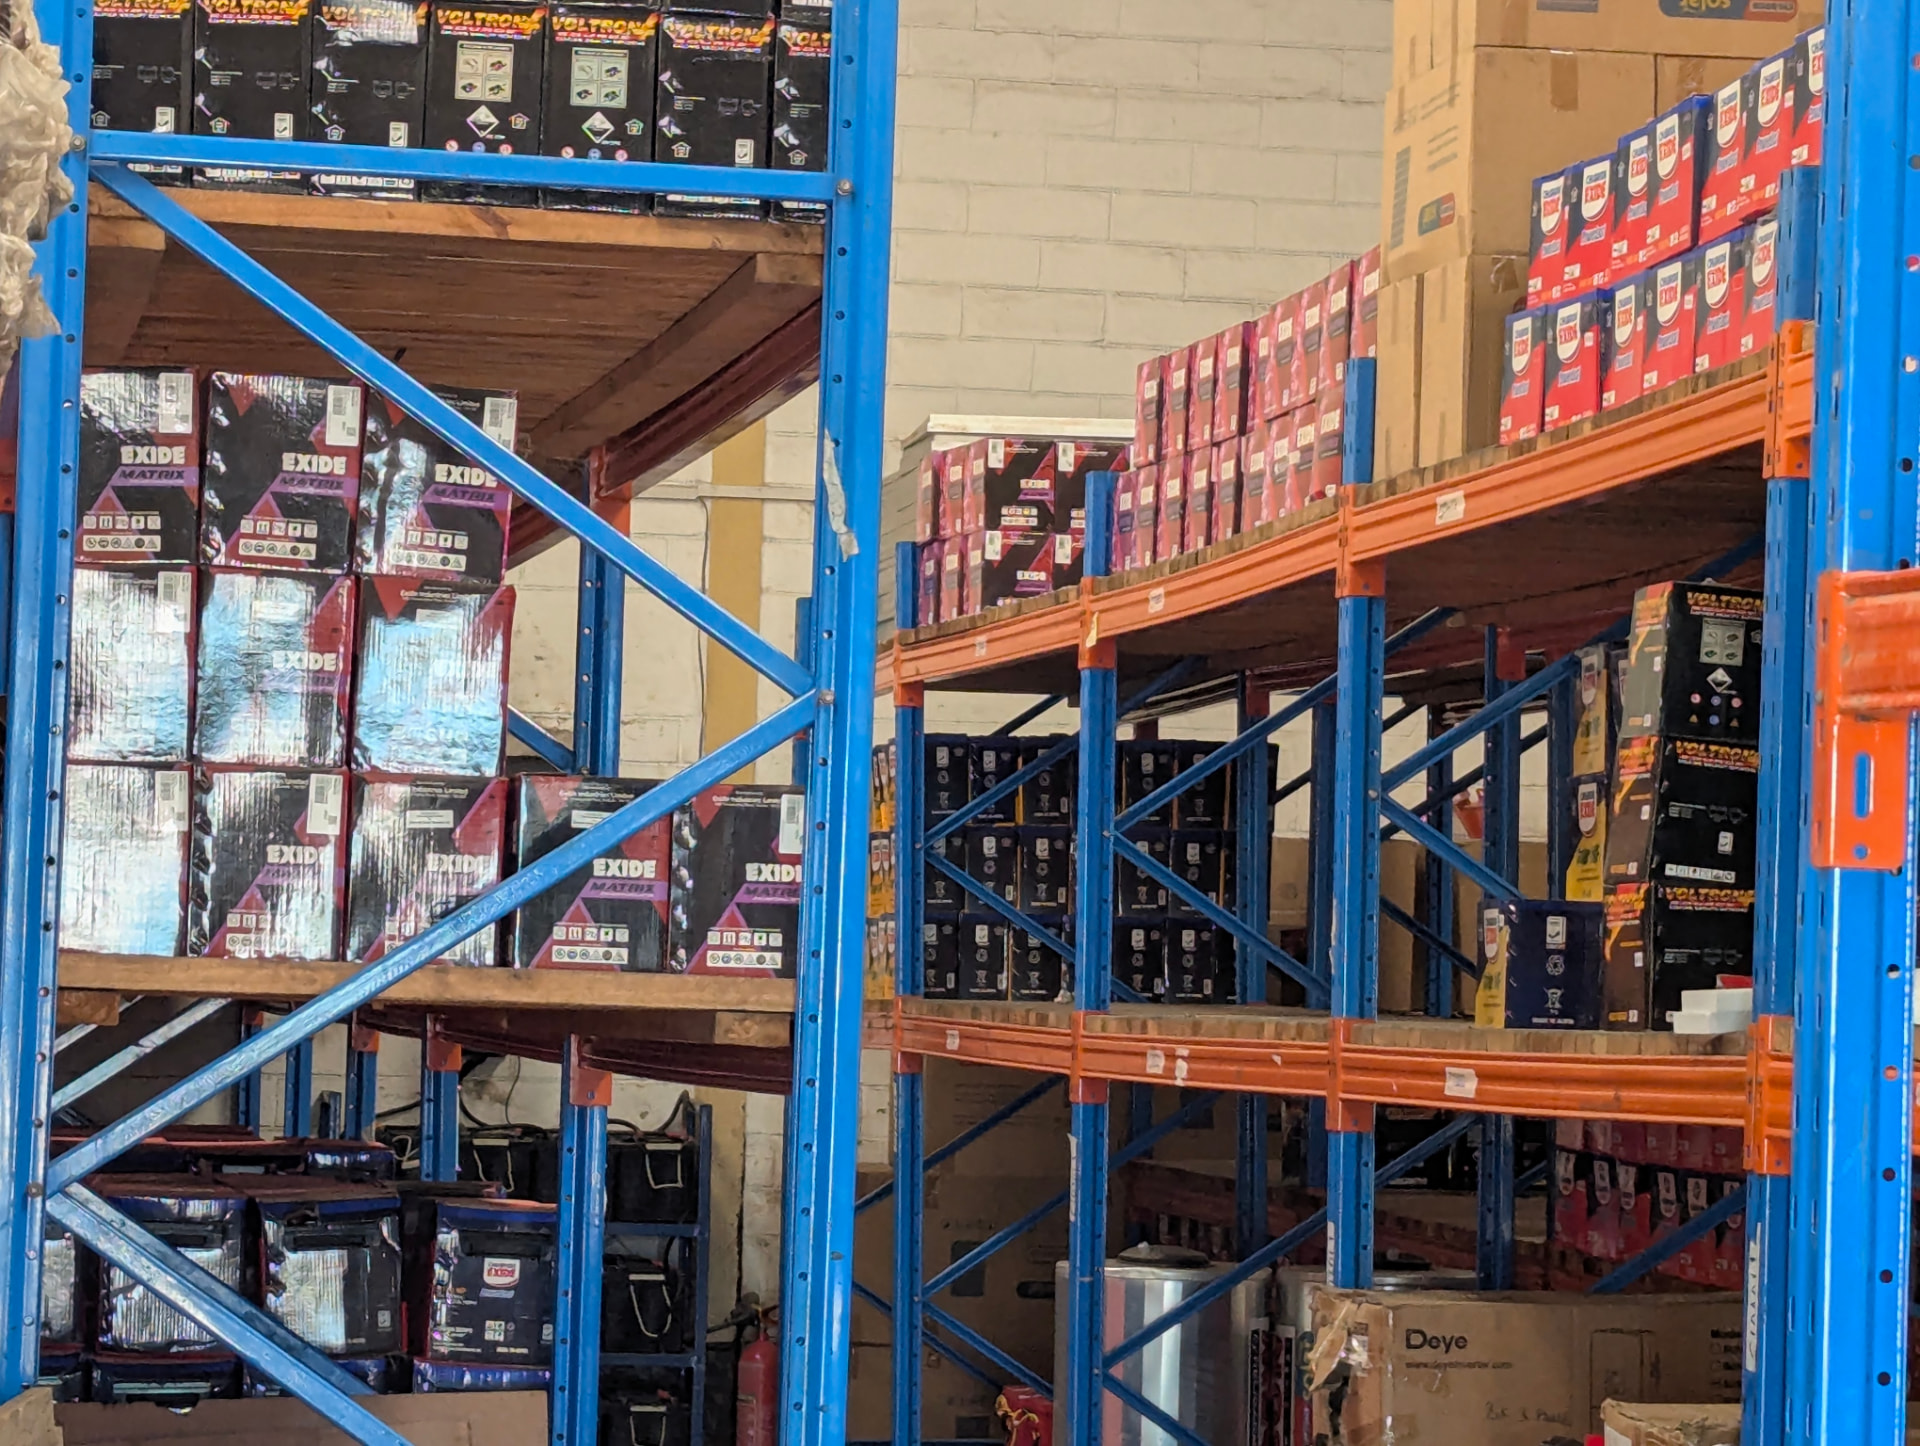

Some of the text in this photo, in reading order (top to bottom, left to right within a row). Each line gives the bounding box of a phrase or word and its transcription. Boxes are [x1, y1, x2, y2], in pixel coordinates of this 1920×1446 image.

[437, 9, 528, 28] VOLTRON
[552, 16, 642, 34] VOLTRON
[121, 445, 186, 465] EXIDE
[282, 452, 347, 475] EXIDE
[119, 469, 185, 481] MATRIX
[279, 476, 344, 490] MATRIX
[434, 463, 498, 488] EXIDE
[432, 487, 496, 501] MATRIX
[272, 651, 337, 672] EXIDE
[266, 844, 326, 865] EXID
[593, 858, 656, 879] EXIDE
[589, 881, 655, 895] MATRIX
[1405, 1328, 1468, 1354] Deye
